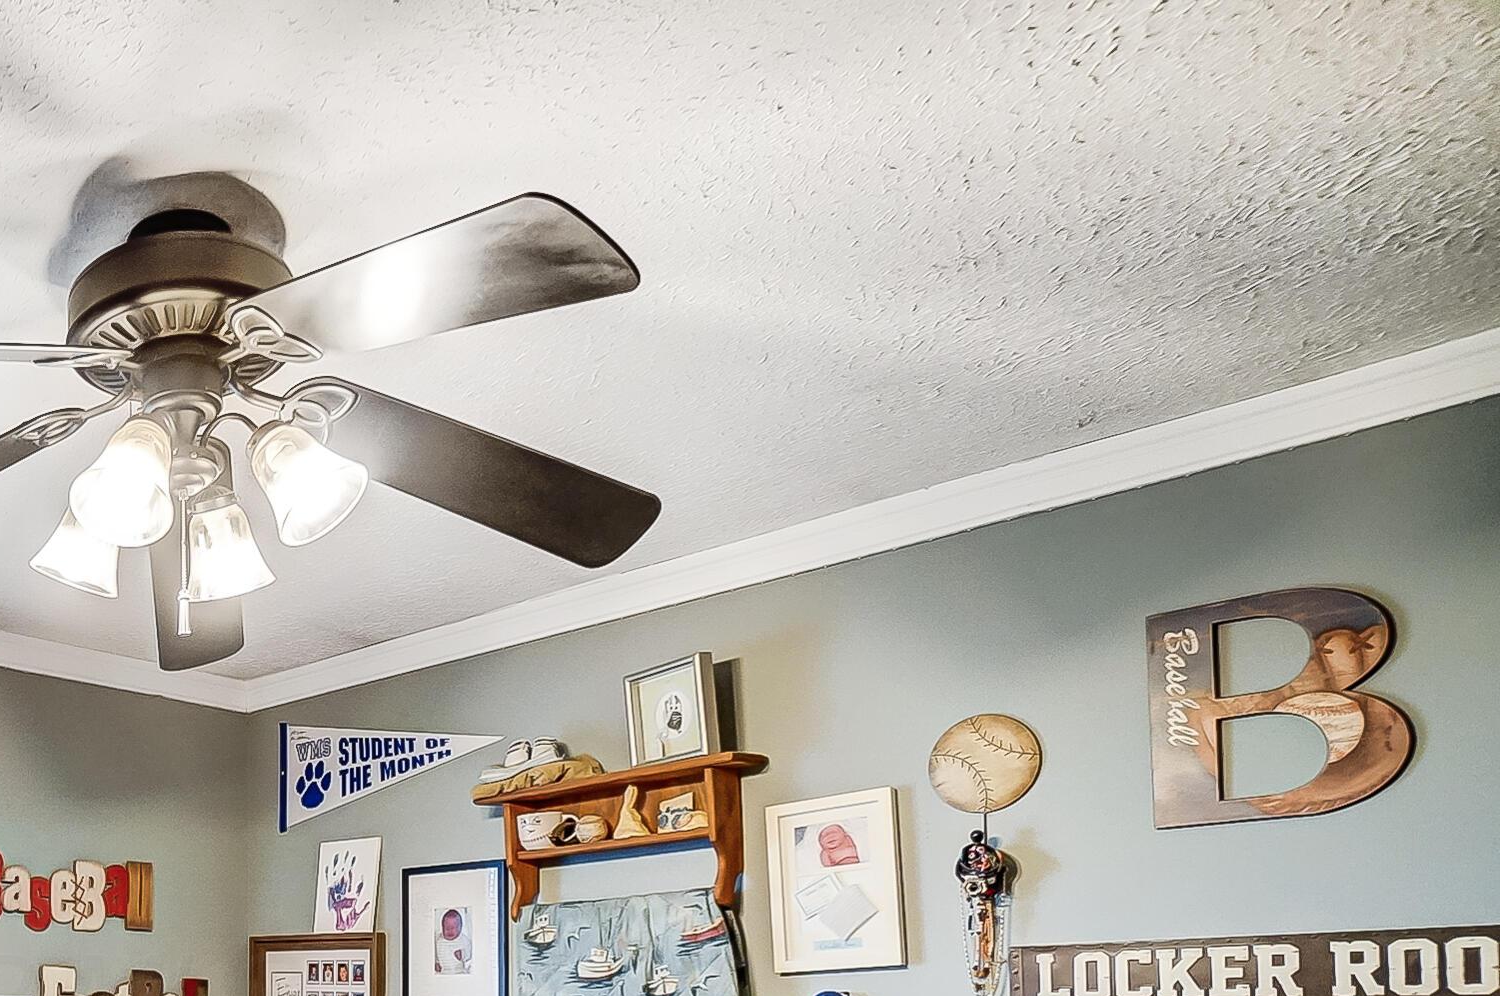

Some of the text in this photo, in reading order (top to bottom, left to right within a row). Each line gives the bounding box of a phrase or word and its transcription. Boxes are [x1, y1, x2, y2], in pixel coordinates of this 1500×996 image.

[1163, 628, 1200, 746] Baseball
[296, 738, 331, 762] WMS
[339, 737, 451, 766] STUDENT OF
[339, 749, 452, 797] THE MONTH
